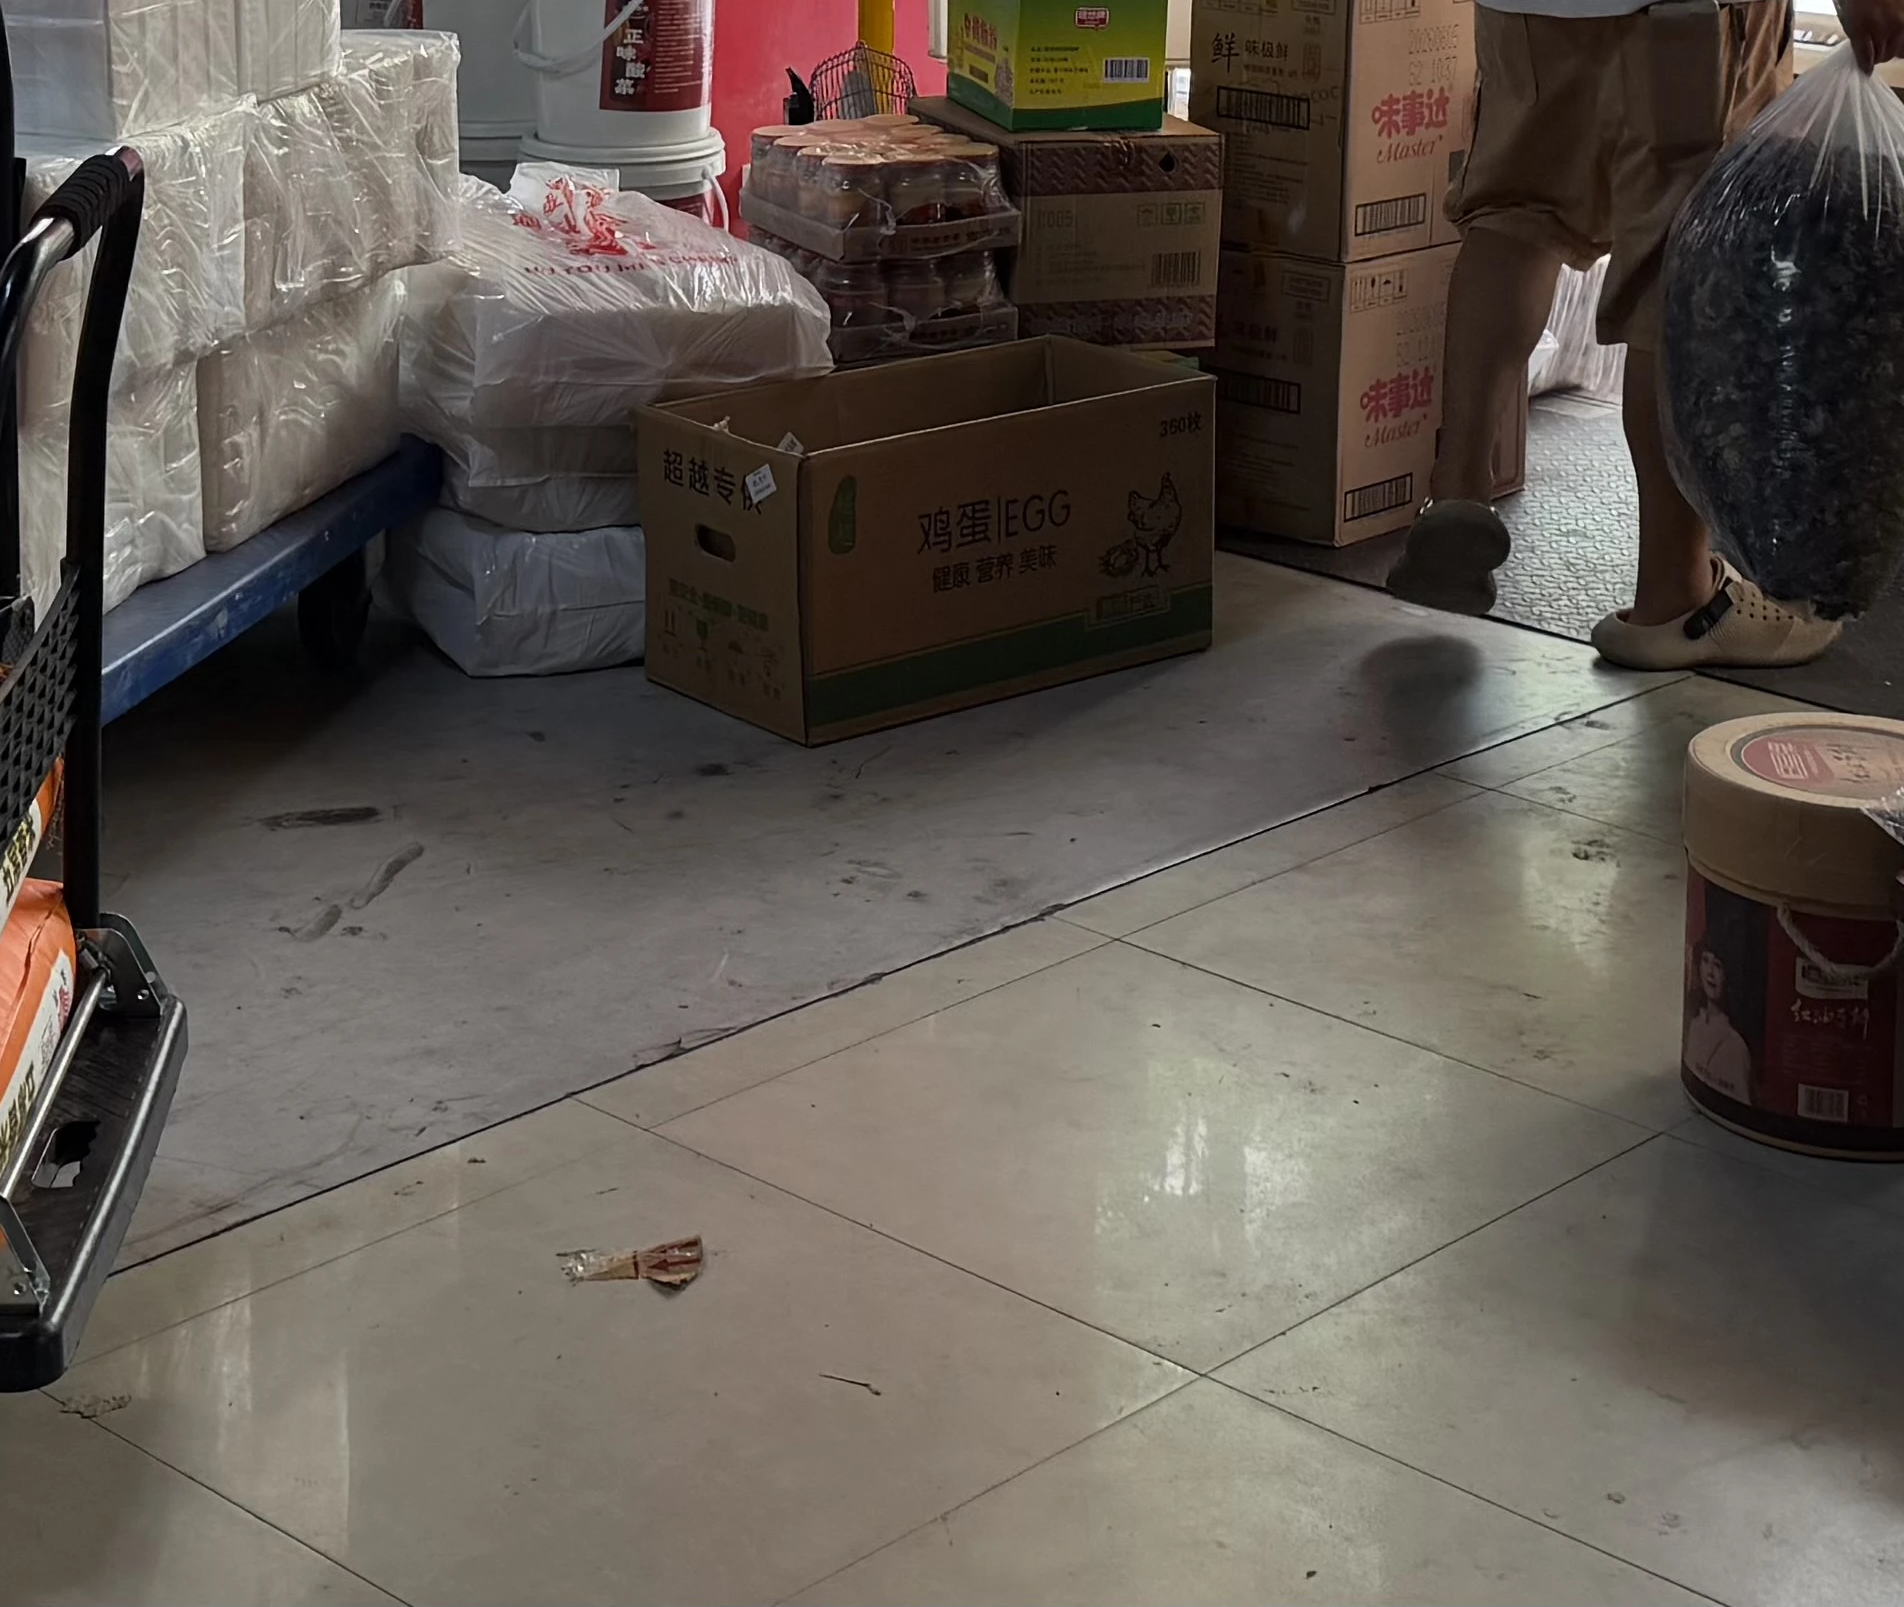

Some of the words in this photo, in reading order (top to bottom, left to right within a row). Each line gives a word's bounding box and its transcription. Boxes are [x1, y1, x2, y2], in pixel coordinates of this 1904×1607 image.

[1211, 32, 1238, 74] 鲜
[1371, 86, 1450, 139] 味事达
[1377, 138, 1436, 165] Master
[1360, 366, 1434, 423] 味事达
[1160, 411, 1203, 438] 360枚
[917, 501, 992, 555] 鸡蛋
[1005, 489, 1072, 538] EGG
[932, 566, 971, 594] 健康
[975, 557, 1015, 586] 营养
[1019, 545, 1059, 575] 美味
